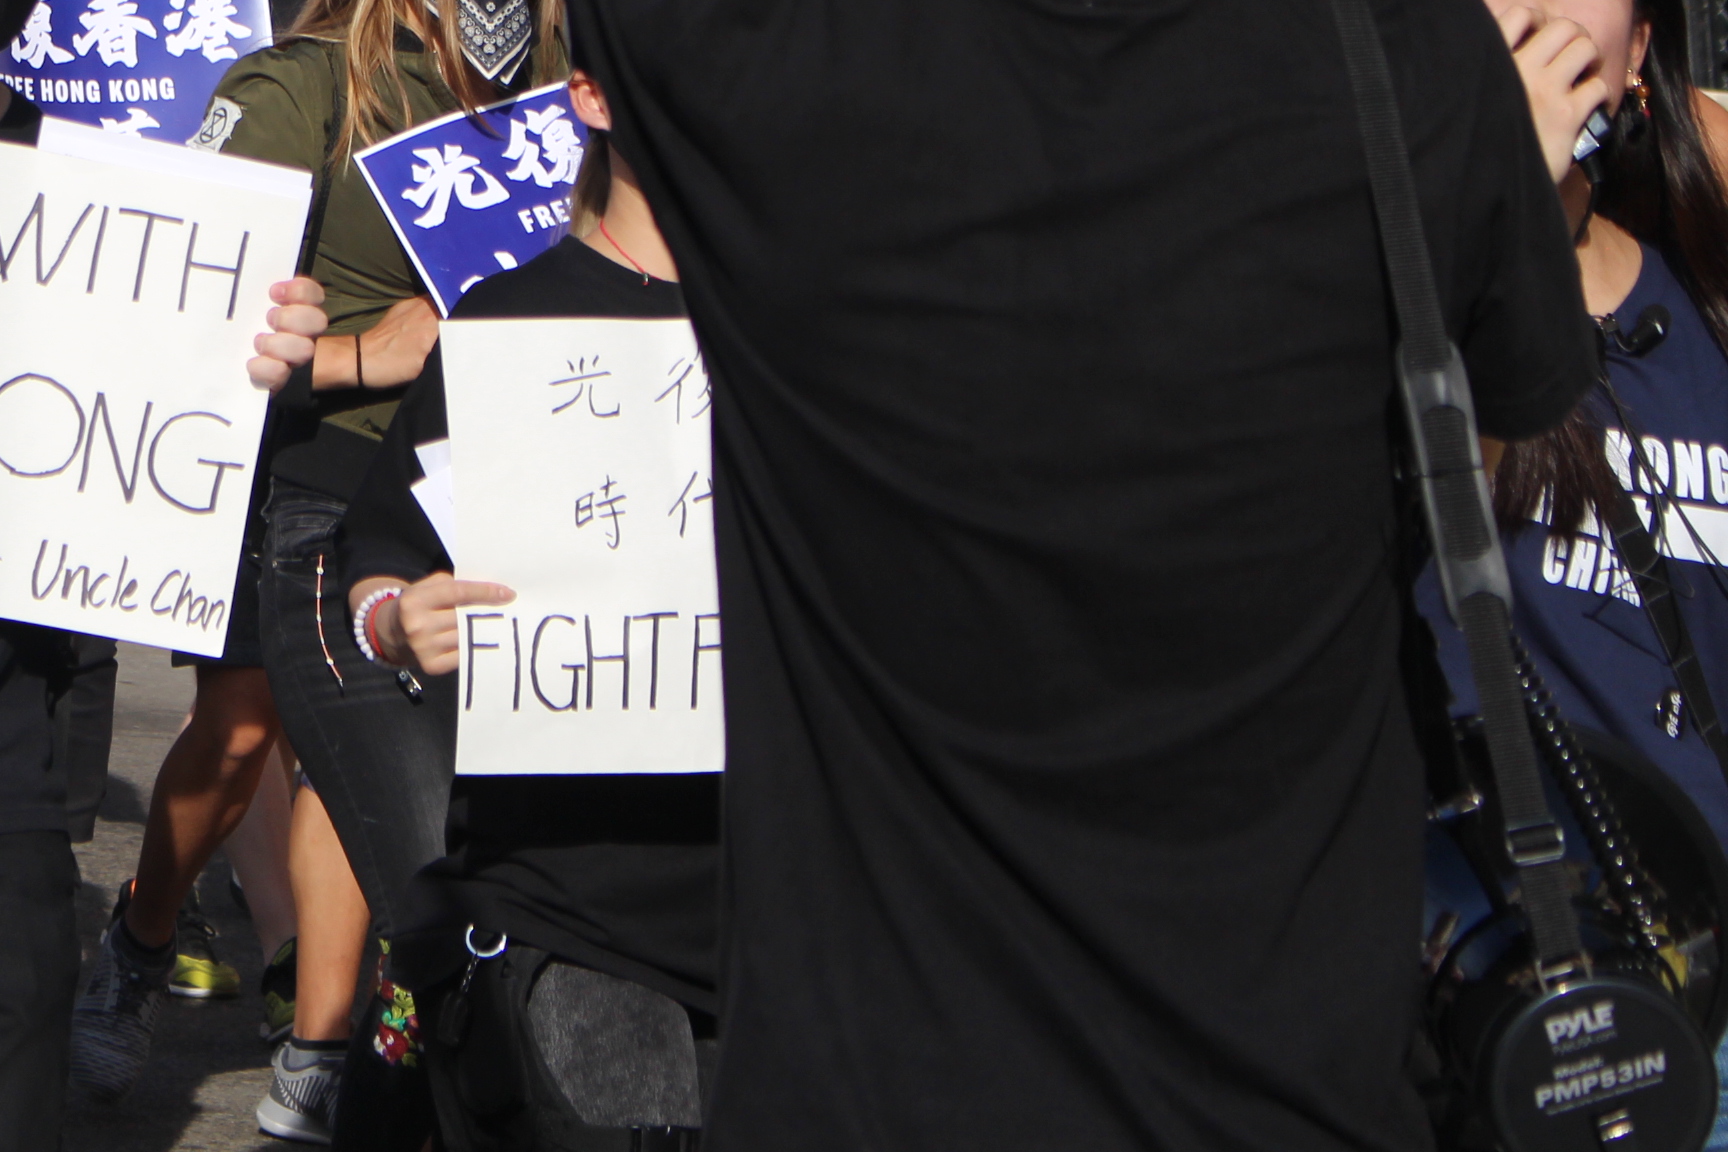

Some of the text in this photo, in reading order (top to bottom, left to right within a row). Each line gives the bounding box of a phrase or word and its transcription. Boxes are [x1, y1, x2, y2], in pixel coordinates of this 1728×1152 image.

[40, 77, 101, 104] HONG
[108, 77, 175, 101] KONG
[517, 198, 573, 234] FRE
[30, 536, 140, 612] Uncle
[148, 569, 227, 633] Chan
[1543, 999, 1615, 1045] PYLE
